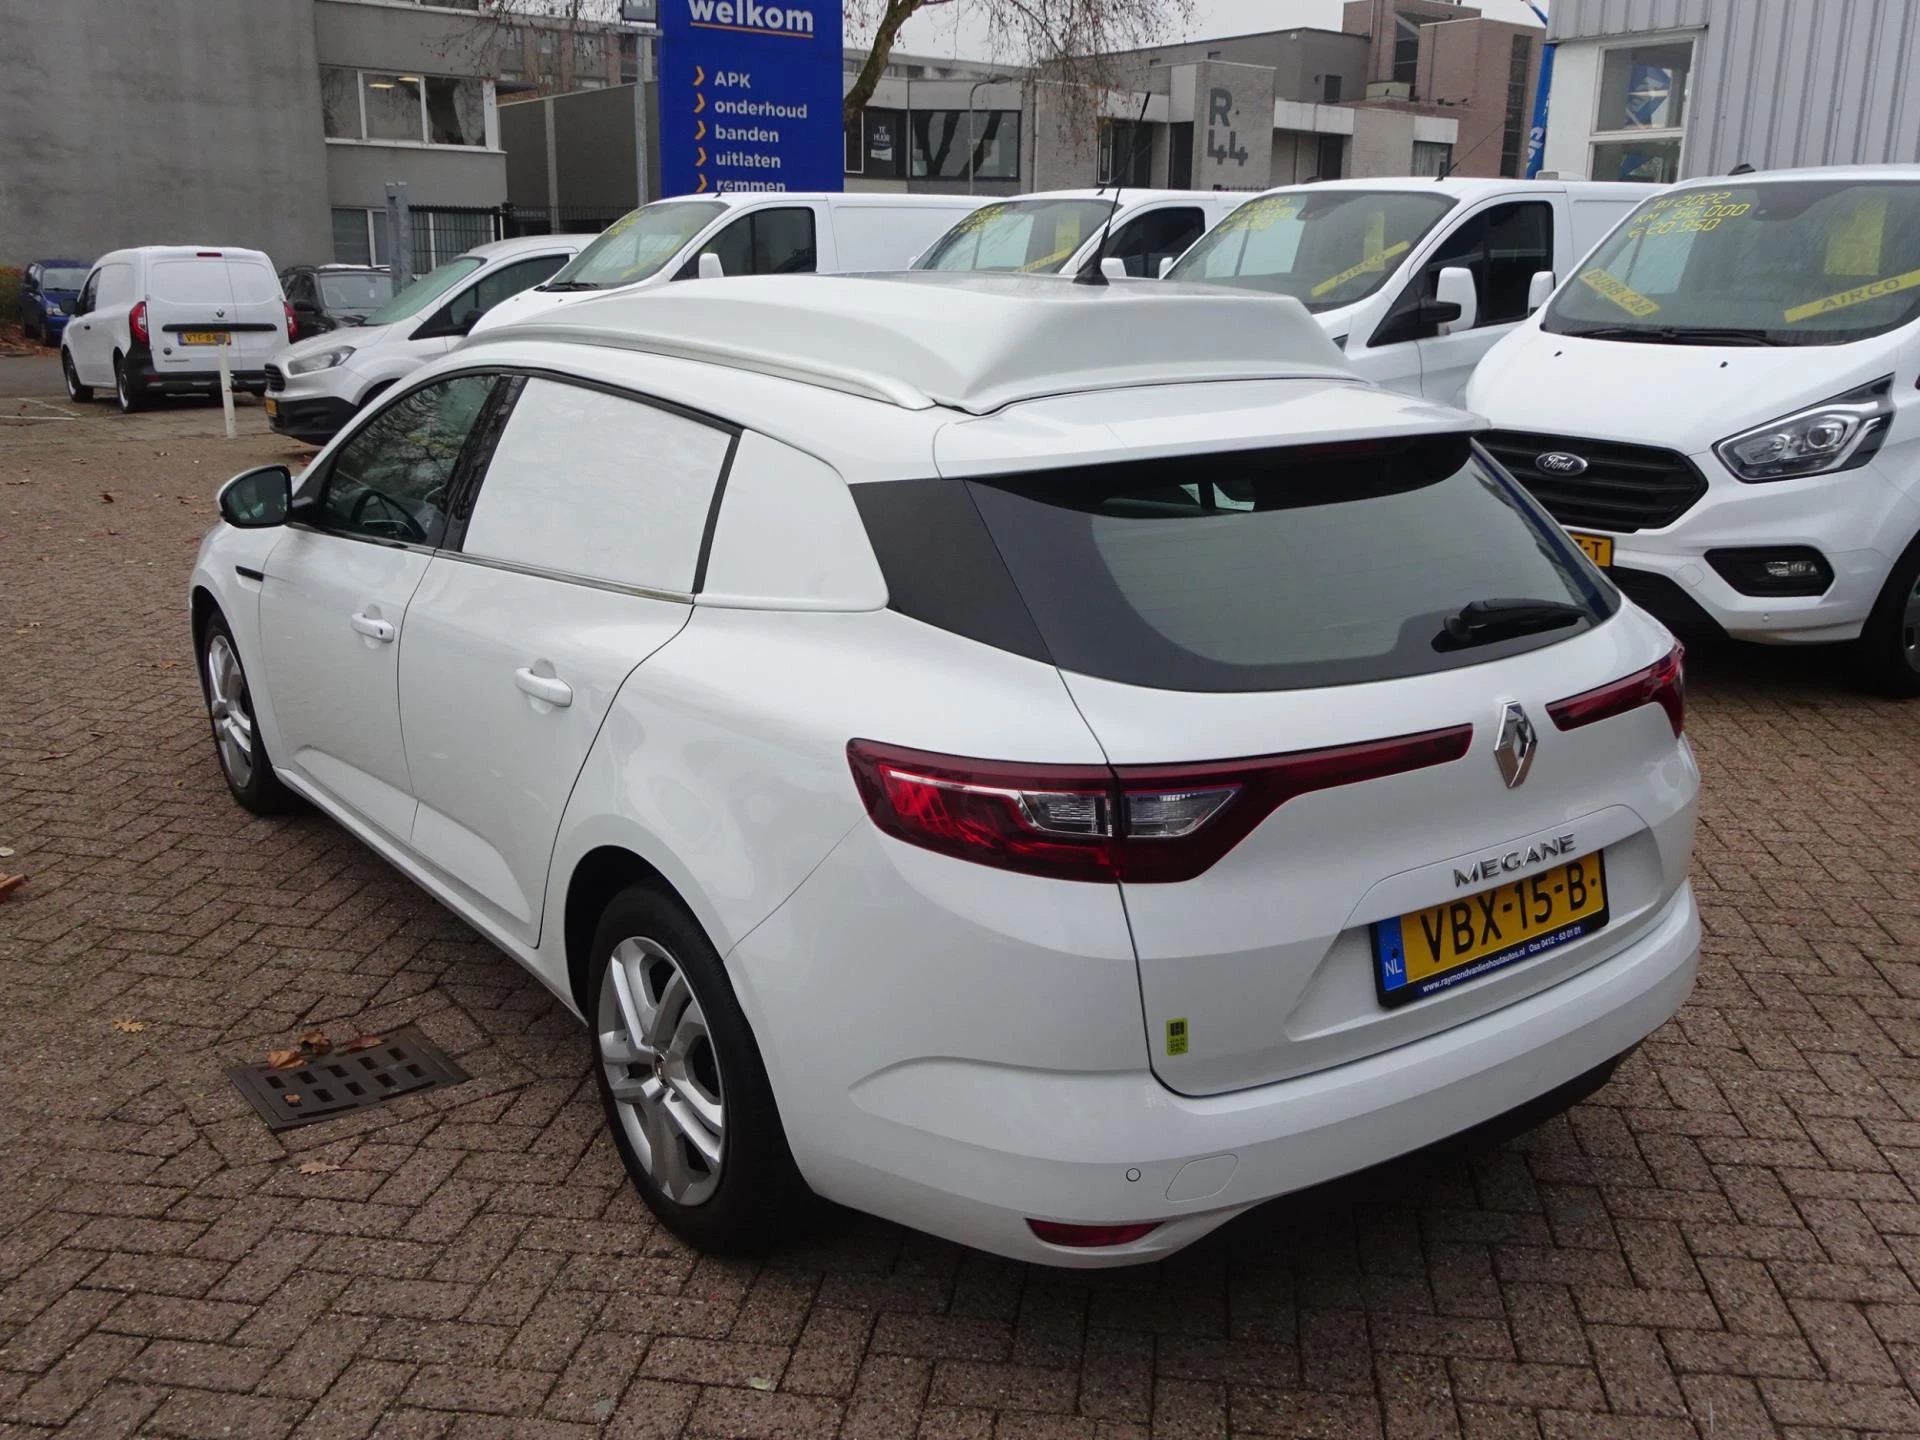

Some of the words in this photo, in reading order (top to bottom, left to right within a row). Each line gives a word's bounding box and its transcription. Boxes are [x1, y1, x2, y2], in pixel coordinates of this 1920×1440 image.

[689, 0, 813, 32] welkom
[714, 71, 751, 88] APK
[714, 100, 807, 119] onderhoud
[715, 124, 779, 143] banden
[716, 151, 781, 168] uitlaten
[717, 179, 785, 192] remmen
[1822, 279, 1899, 309] AIRCO
[1544, 454, 1574, 470] Ford
[1453, 833, 1576, 888] MEGANE
[1420, 861, 1587, 963] VBX-15-B
[1385, 961, 1402, 977] NL
[1422, 947, 1526, 993] www.raymondvanlieshoutautos.nl
